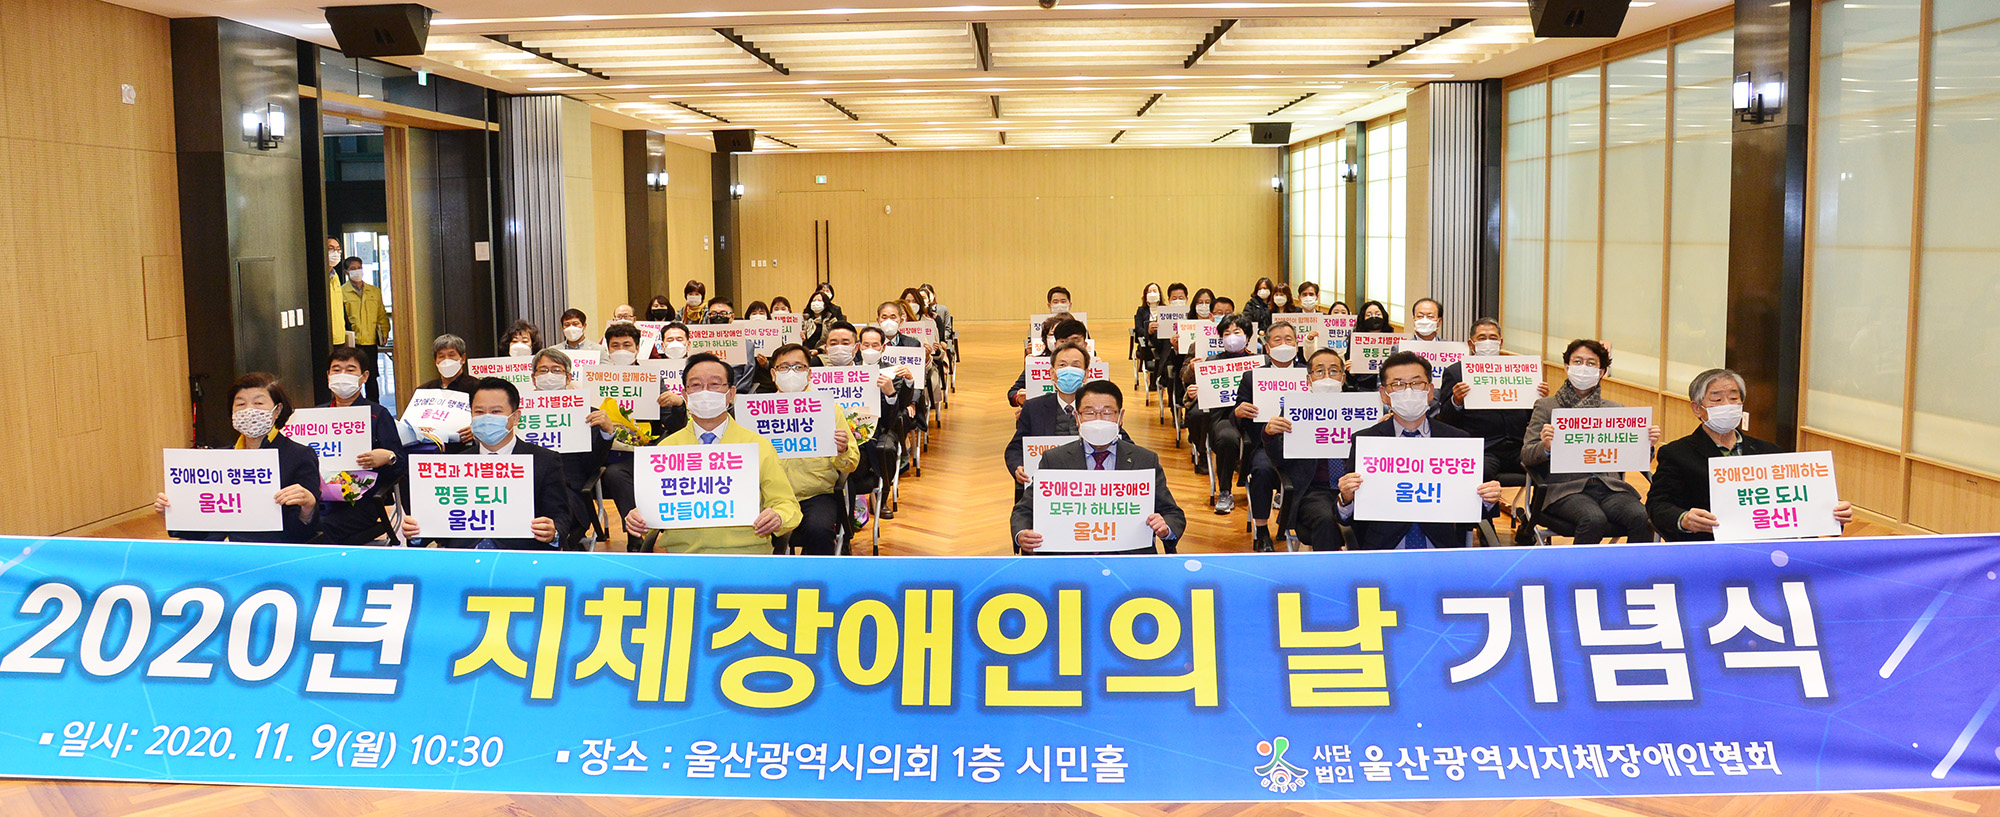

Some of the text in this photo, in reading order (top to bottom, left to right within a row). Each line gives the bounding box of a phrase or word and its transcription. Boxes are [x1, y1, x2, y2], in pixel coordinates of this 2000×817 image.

[1324, 319, 1347, 327] 장애물
[688, 329, 743, 339] 장애인과 비장애인
[758, 328, 779, 336] 당당한
[1329, 329, 1351, 338] 편한세
[692, 339, 738, 348] 모두가 하나되는
[1355, 336, 1377, 345] 편견과
[899, 356, 922, 365] 행복한
[1363, 348, 1379, 357] 평등
[471, 364, 504, 375] 장애인과
[1199, 360, 1260, 376] 편견과 차별없는
[1465, 363, 1538, 375] 장애인과 비장애인
[586, 372, 620, 383] 장애인이
[622, 372, 657, 383] 함께하는
[810, 370, 870, 385] 장애물 없는
[1210, 377, 1230, 390] 평등
[1473, 376, 1533, 386] 모두가 하나되는
[600, 386, 643, 397] 밝은 도시
[1257, 380, 1297, 392] 장애인이
[414, 397, 445, 407] 장애인이
[537, 395, 585, 409] 차별없는
[1489, 388, 1518, 402] 울산!
[747, 399, 790, 416] 장애물
[794, 397, 822, 414] 없는
[1289, 407, 1379, 421] 장애인이 행복한
[421, 409, 450, 421] 울산!
[517, 413, 572, 430] 평등 도시
[283, 421, 366, 438] 장애인이 당당한
[756, 417, 815, 434] 편한세상
[1556, 417, 1647, 430] 장애인과 비장애인
[1314, 427, 1351, 444] 울산!
[1564, 432, 1639, 444] 모두가 하나되는
[770, 436, 818, 454] 들어요!
[650, 452, 744, 473] 장애물 없는
[1583, 448, 1618, 464] 울산!
[417, 462, 525, 479] 편견과 차별없는
[1363, 457, 1476, 475] 장애인이 당당한
[1713, 462, 1829, 483] 장애인이 함께하는
[170, 467, 272, 485] 장애인이 행복한
[661, 475, 733, 497] 편한세상
[1039, 481, 1150, 497] 장애인과 비장애인
[1395, 482, 1441, 504] 울산!
[434, 486, 508, 505] 평등 도시
[1737, 485, 1808, 505] 밝은 도시
[199, 493, 242, 514] 울산!
[659, 500, 735, 522] 만들어요!
[1050, 502, 1140, 516] 모두가 하나되는
[448, 509, 495, 531] 울산!
[1752, 507, 1798, 529] 울산!
[1073, 522, 1117, 541] 울산!
[0, 581, 1829, 709] 2020년 지체장애인의 날 기념식
[58, 720, 503, 769] 일시: 2020. 11. 9(월) 10:30
[578, 739, 650, 775] 장소
[685, 743, 938, 782] 울산광역시의회
[953, 745, 1005, 782] 1층
[1016, 745, 1128, 783] 시민홀
[1313, 745, 1351, 763] 사단
[1359, 741, 1782, 782] 울산광역시지체장애인협회
[1315, 765, 1354, 784] 법인
